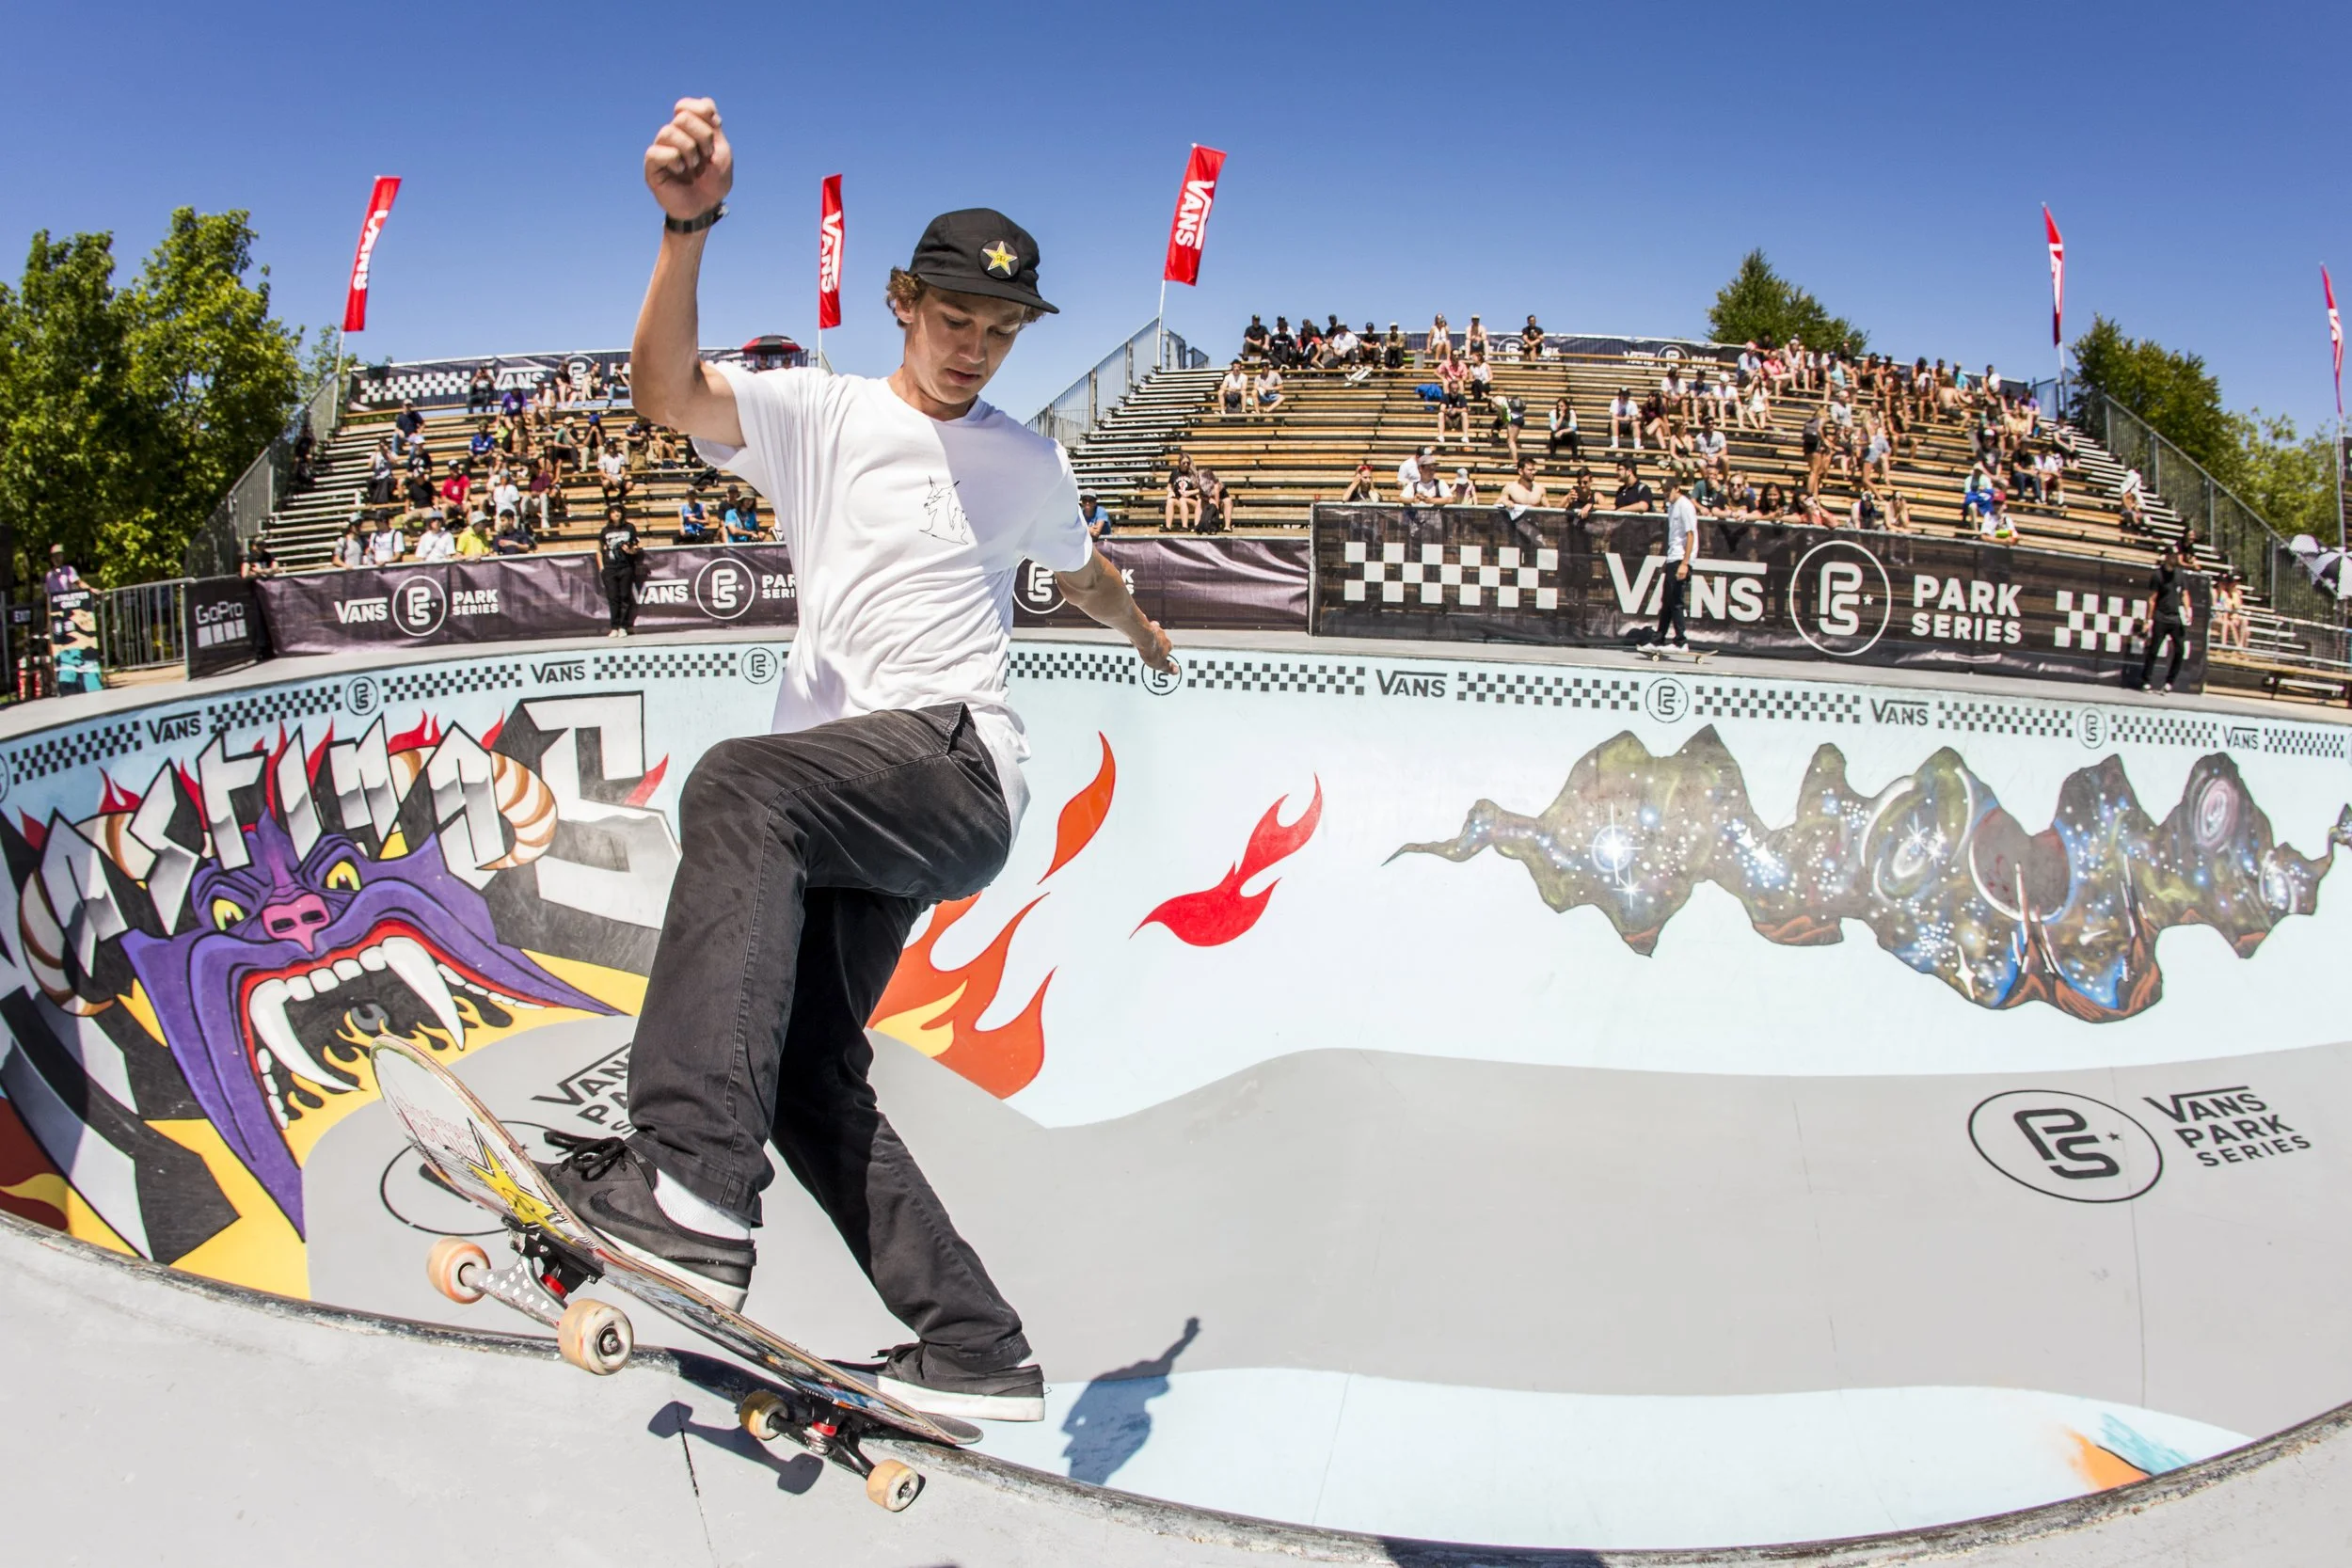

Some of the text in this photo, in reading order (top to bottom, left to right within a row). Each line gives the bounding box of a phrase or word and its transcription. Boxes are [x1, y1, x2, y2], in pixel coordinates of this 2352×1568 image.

[1175, 180, 1215, 250] VANS
[820, 210, 843, 293] VANS
[452, 589, 498, 605] PARK
[632, 578, 689, 605] VANS
[761, 574, 797, 589] PAR
[761, 589, 797, 599] SERI
[1605, 552, 1767, 623] VANS
[1913, 575, 2023, 618] PARK
[195, 601, 244, 625] GoPro
[333, 597, 388, 624] VANS
[452, 603, 499, 616] SERIES
[1911, 612, 2023, 645] SERIES
[531, 660, 586, 685] VANS
[1375, 670, 1449, 699] VANS
[147, 711, 202, 744] VANS
[1869, 698, 1930, 727] VANS
[2222, 725, 2260, 750] VANS
[530, 1041, 632, 1107] VAN
[576, 1091, 628, 1126] PA
[2141, 1085, 2269, 1124] VANS
[2174, 1114, 2295, 1149] PARK
[2195, 1134, 2312, 1168] SERIES
